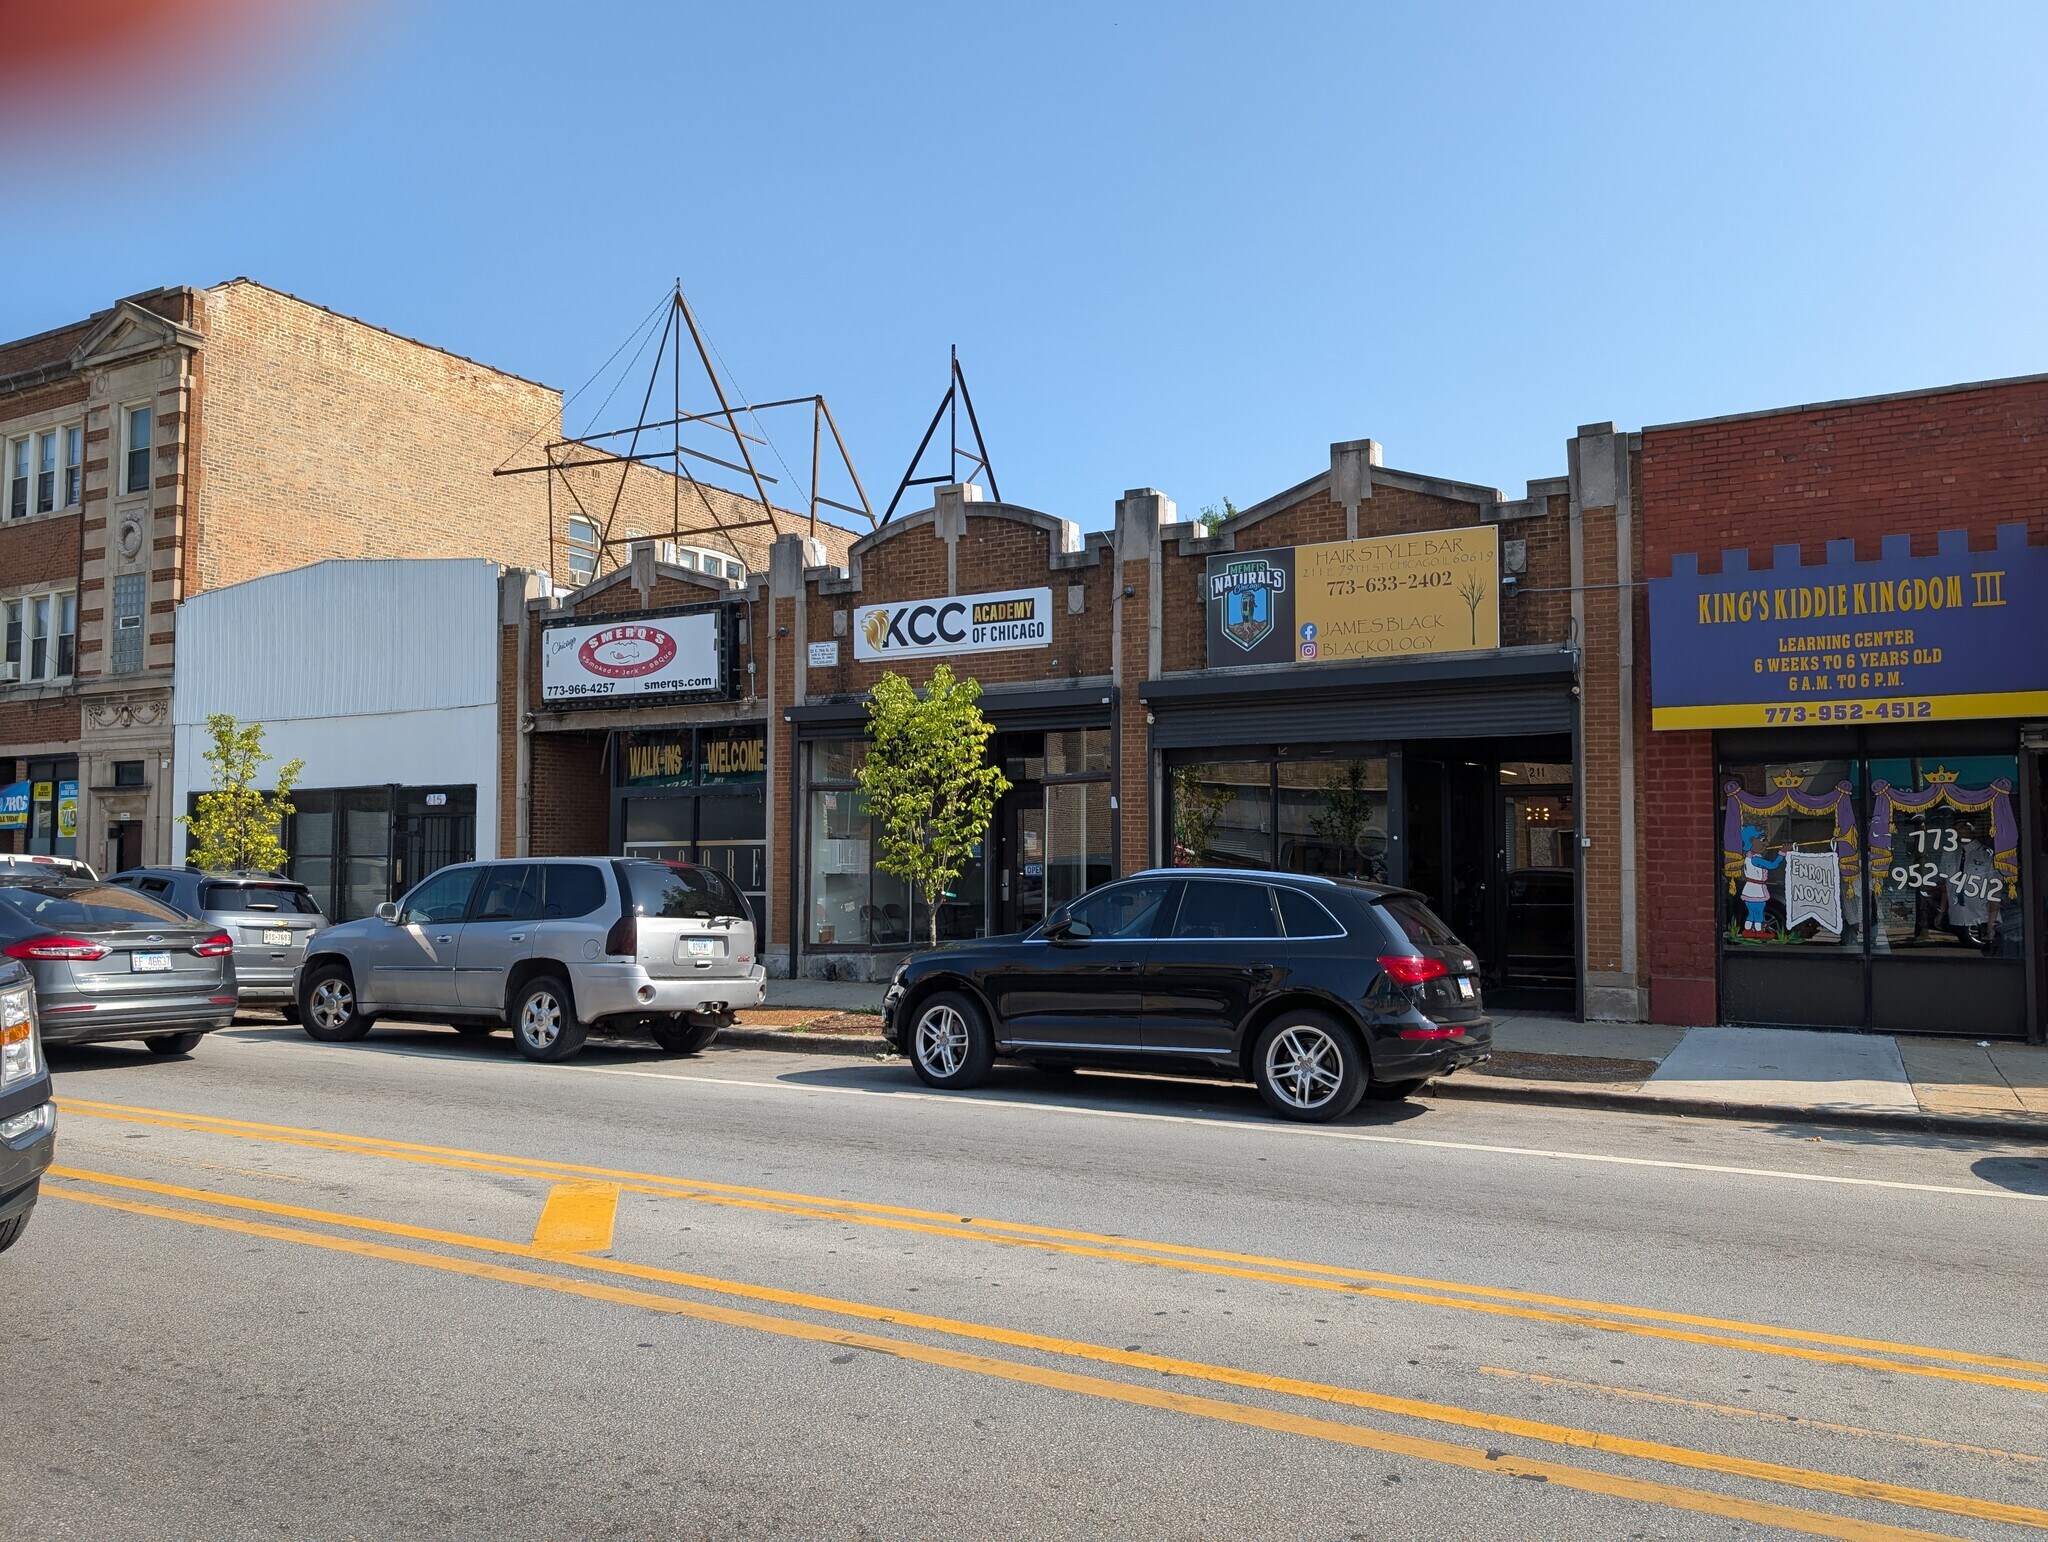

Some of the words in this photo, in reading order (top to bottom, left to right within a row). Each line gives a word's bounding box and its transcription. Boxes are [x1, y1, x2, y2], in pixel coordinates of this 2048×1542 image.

[1316, 549, 1356, 565] HAIR
[1358, 542, 1422, 561] STYLE
[1425, 538, 1463, 554] BAR
[1453, 551, 1493, 565] 60619
[1230, 562, 1265, 575] MEMFIS
[1214, 571, 1282, 594] NATURALS
[1326, 570, 1452, 597] 773-633-2402
[1698, 589, 1769, 624] KING'S
[1774, 584, 1848, 620] KIDDIE
[1853, 575, 1963, 615] KINGDOM
[1971, 571, 2007, 607] III
[882, 602, 967, 648] KCC
[974, 600, 1033, 623] ACADEMY
[972, 627, 987, 643] OF
[990, 621, 1045, 642] CHICAGO
[1320, 617, 1383, 637] JAMES
[1386, 614, 1445, 632] BLACK
[551, 636, 577, 655] Chicago
[588, 627, 666, 649] SMERQ'S
[1322, 635, 1436, 656] BLACKOLOGY
[1779, 634, 1850, 653] LEARNING
[1854, 629, 1914, 648] CENTER
[584, 658, 611, 674] Smoked
[1754, 658, 1763, 673] 6
[1767, 656, 1819, 672] WEEKS
[1823, 655, 1842, 670] TO
[1847, 654, 1855, 669] 6
[1860, 651, 1909, 667] YEARS
[1913, 648, 1942, 664] OLD
[547, 682, 616, 696] 773-966-4257
[644, 677, 712, 691] smerqs.com
[1789, 677, 1797, 691] 6
[1802, 675, 1832, 691] A.M.
[1837, 674, 1856, 689] TO
[1861, 673, 1869, 688] 6
[1874, 671, 1904, 687] P.M.
[1765, 701, 1931, 723] 773-952-4512
[630, 745, 682, 777] WALK-INS
[707, 739, 765, 773] WELCOME
[1529, 767, 1545, 777] 211
[1791, 858, 1835, 889] ENROLL
[1891, 862, 2004, 902] 952-4512
[1793, 884, 1831, 905] NOW
